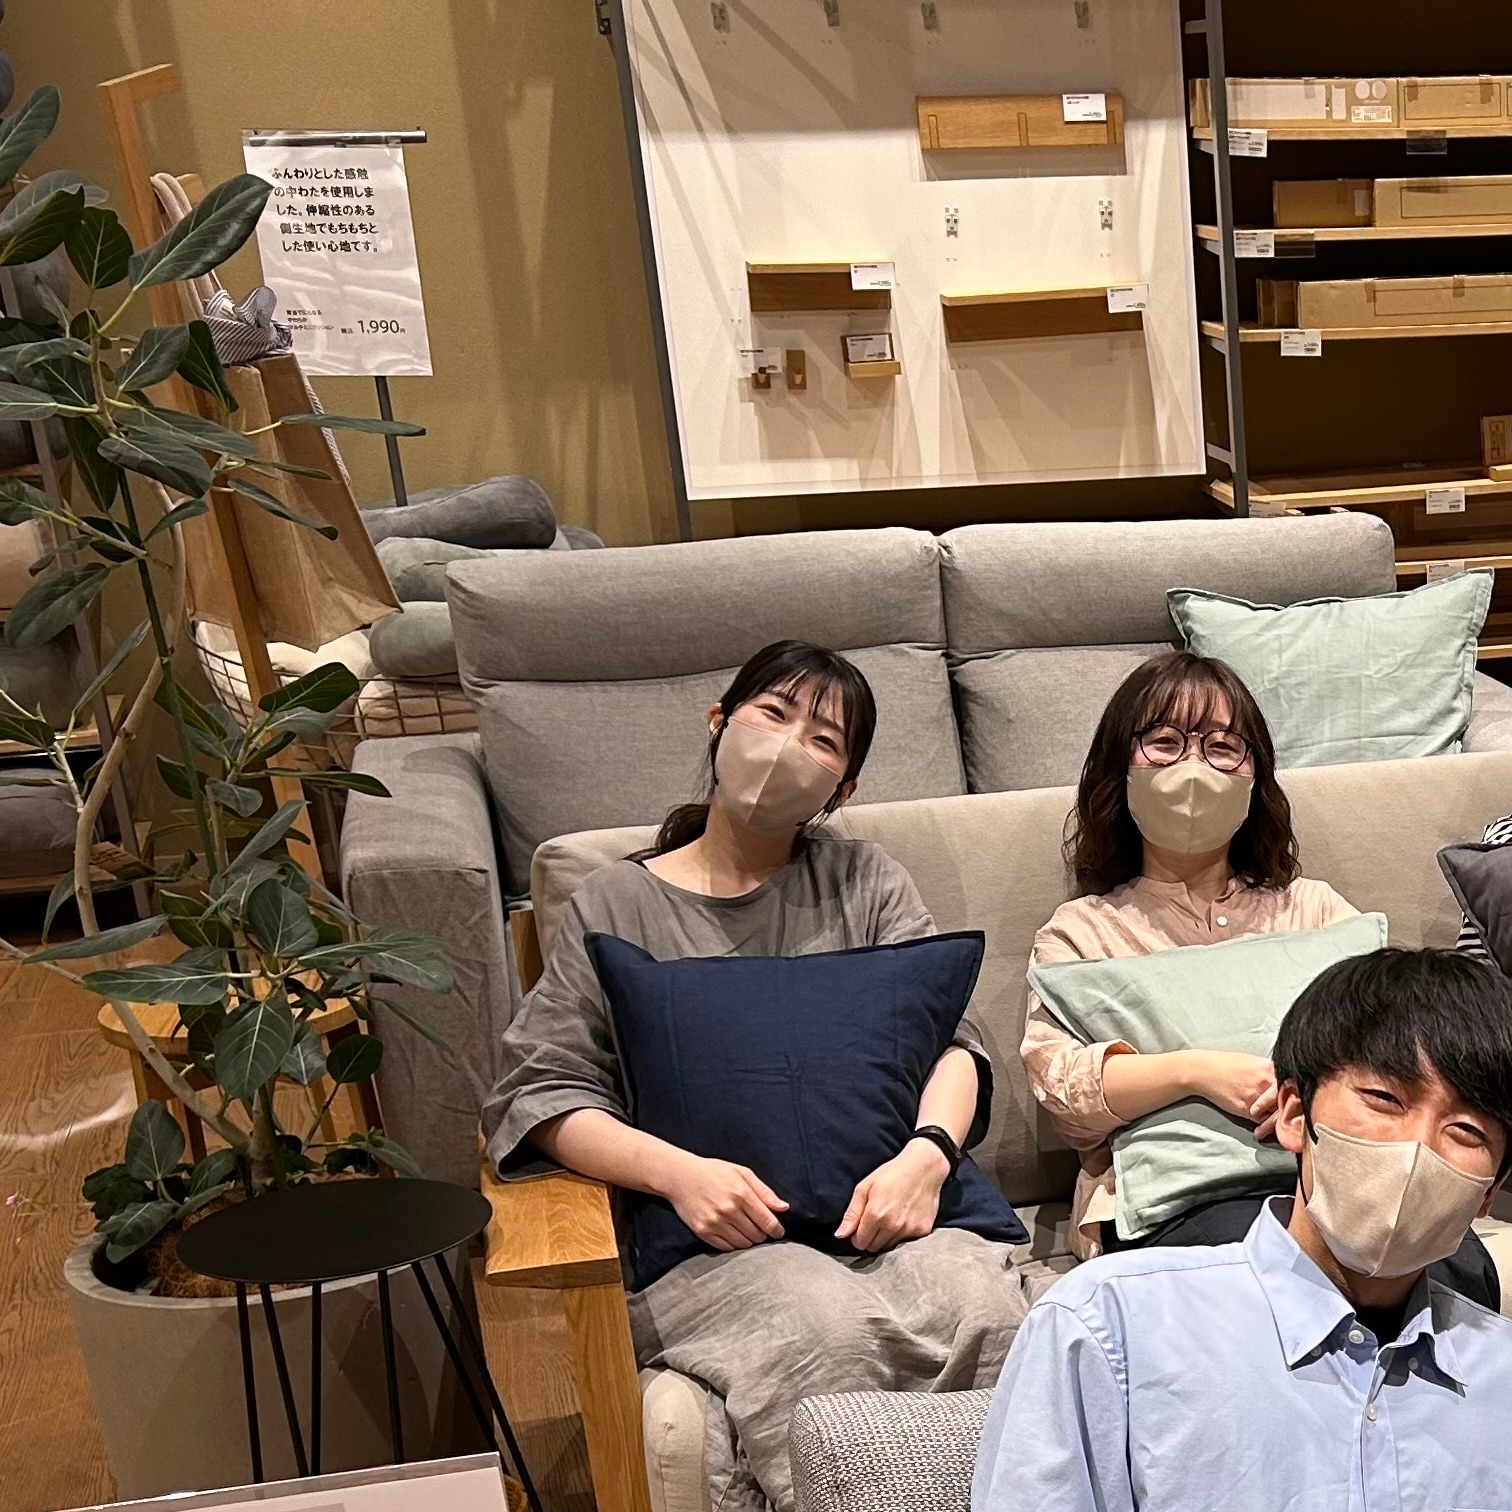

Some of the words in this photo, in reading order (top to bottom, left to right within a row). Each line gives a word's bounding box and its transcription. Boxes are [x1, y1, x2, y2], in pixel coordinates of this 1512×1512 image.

[271, 167, 369, 180] ふんわりとした感触
[274, 185, 375, 198] の中わたを使用しま
[276, 203, 376, 217] した。伸縮性のある
[280, 222, 379, 235] 側生地でもちもちと
[281, 240, 378, 253] した使い心地です。
